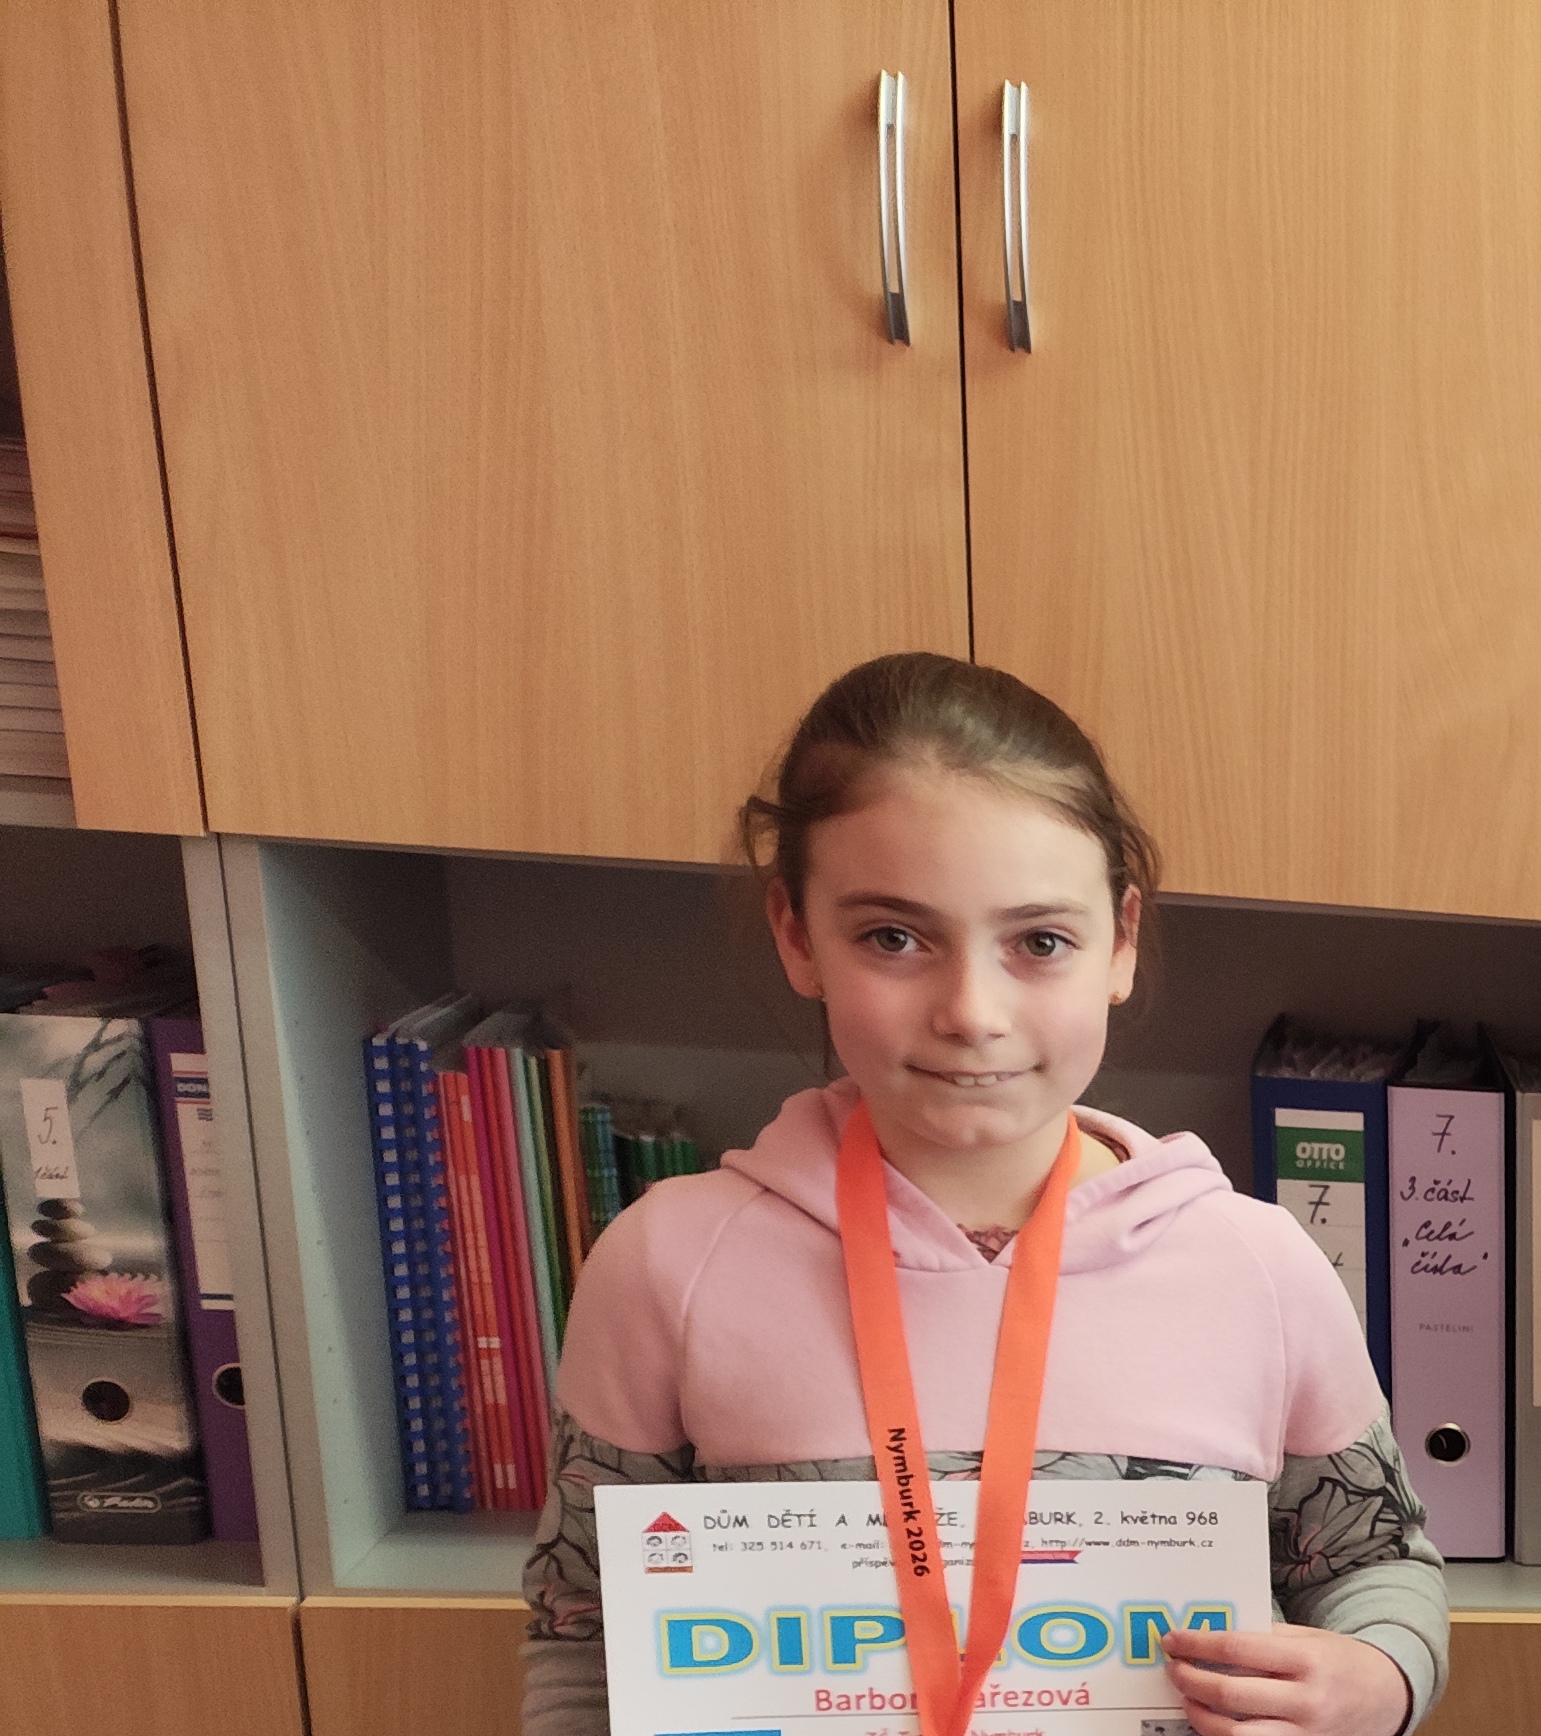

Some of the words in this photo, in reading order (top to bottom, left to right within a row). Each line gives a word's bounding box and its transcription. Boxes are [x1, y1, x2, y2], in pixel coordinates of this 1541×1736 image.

[1432, 1114, 1457, 1155] 7.
[1296, 1142, 1345, 1161] OTTO
[1296, 1160, 1345, 1170] OFFICE
[1308, 1184, 1331, 1224] 7.
[886, 1428, 921, 1523] Nymburk
[906, 1527, 930, 1577] 2026
[703, 1509, 750, 1530] DŮM
[767, 1508, 817, 1529] DĚTÍ
[835, 1513, 848, 1527] A
[1120, 1510, 1177, 1526] května
[1185, 1511, 1218, 1526] 968
